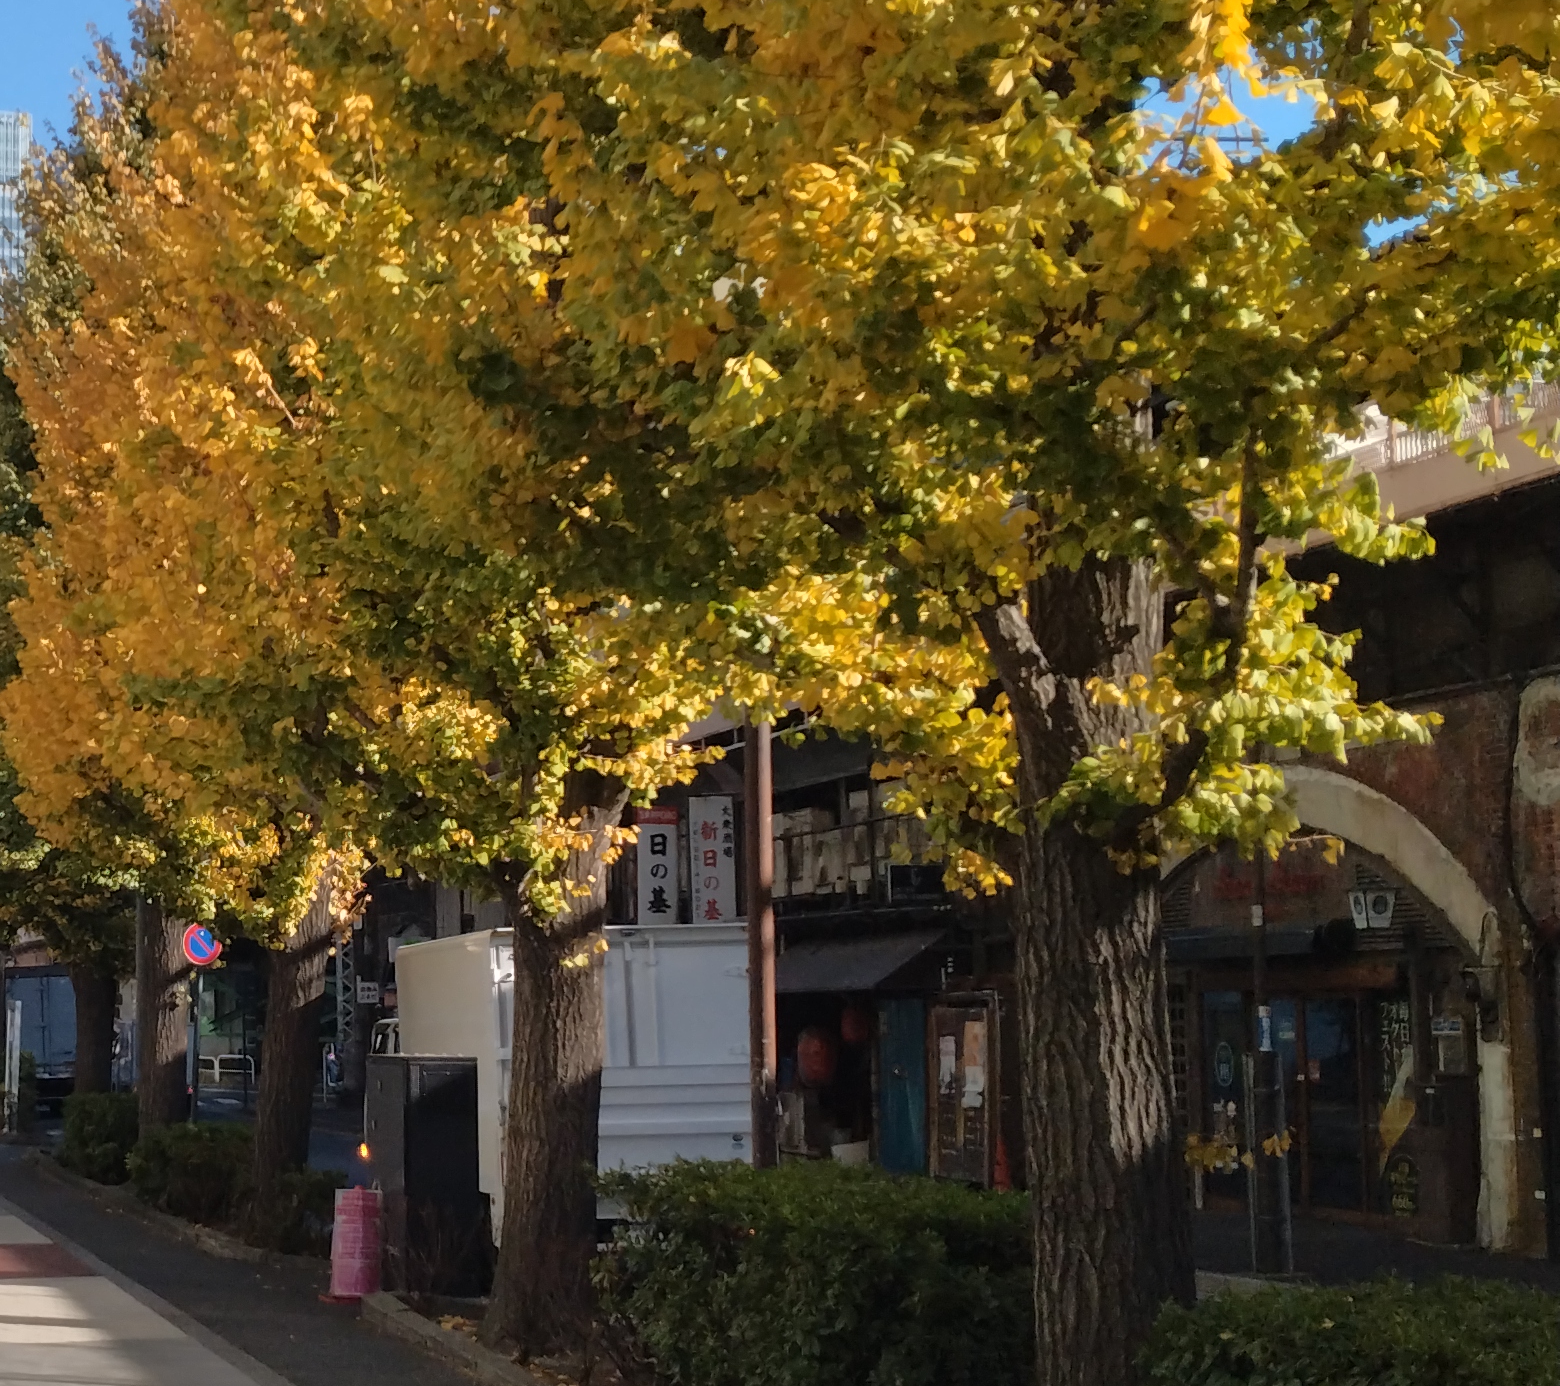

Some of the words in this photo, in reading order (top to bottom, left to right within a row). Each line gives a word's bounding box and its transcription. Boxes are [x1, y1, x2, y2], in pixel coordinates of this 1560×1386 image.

[647, 833, 672, 913] 日の基
[700, 820, 723, 920] 新日の基
